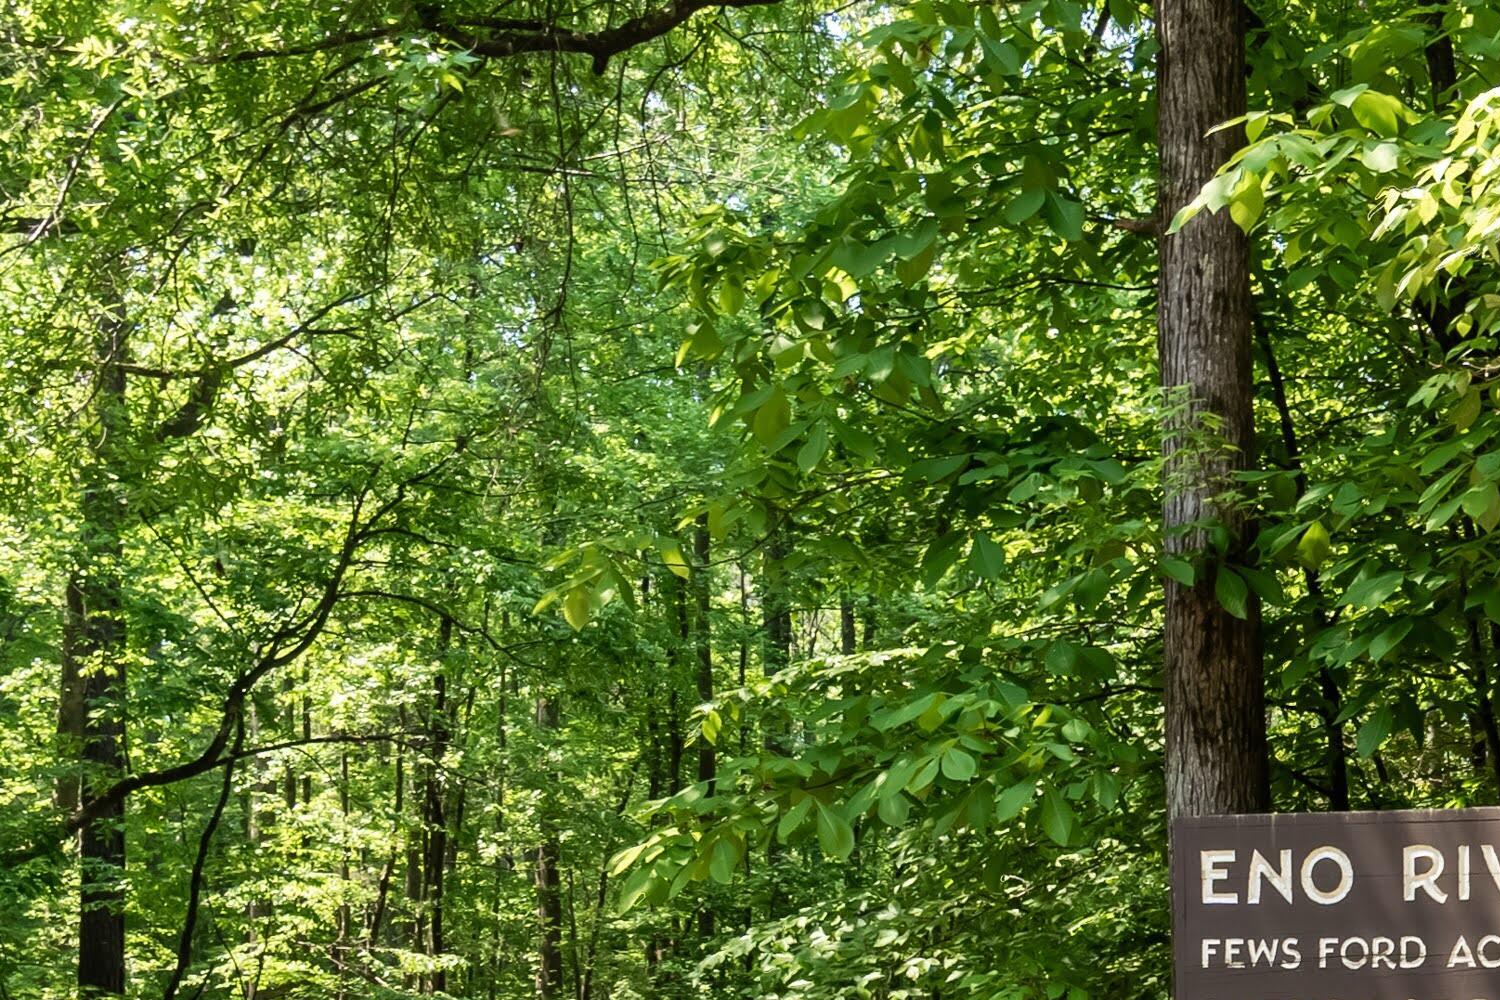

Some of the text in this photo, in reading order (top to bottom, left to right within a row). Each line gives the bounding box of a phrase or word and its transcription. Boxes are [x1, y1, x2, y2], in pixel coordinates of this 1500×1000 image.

[1200, 845, 1354, 906] ENO
[1201, 937, 1303, 970] FEWS
[1318, 935, 1428, 970] FORD
